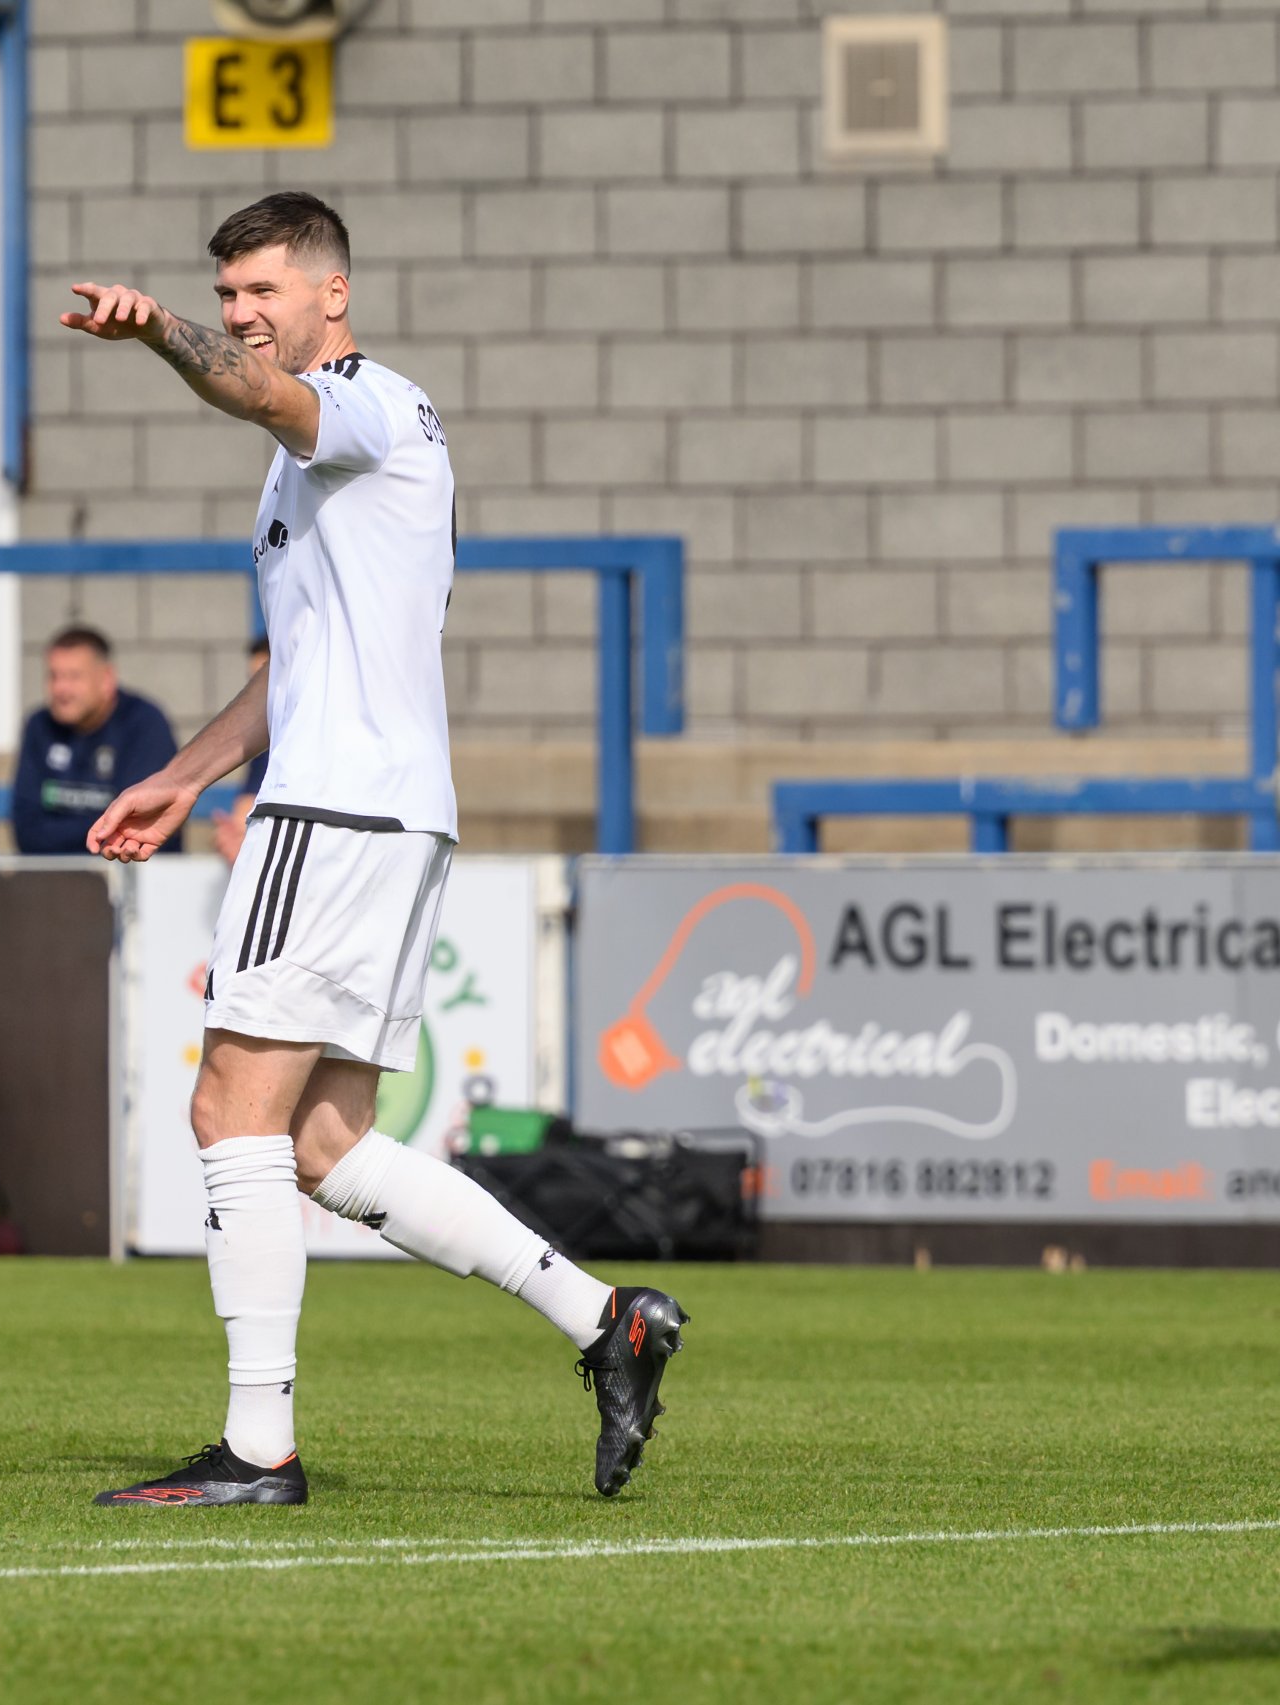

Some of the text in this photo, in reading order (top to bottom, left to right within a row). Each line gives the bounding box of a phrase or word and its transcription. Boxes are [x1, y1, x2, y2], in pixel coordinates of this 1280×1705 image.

[213, 51, 305, 130] E 3
[831, 903, 1280, 970] AGL Electrica
[688, 1009, 972, 1077] electrical
[1035, 1011, 1269, 1069] Domestic,
